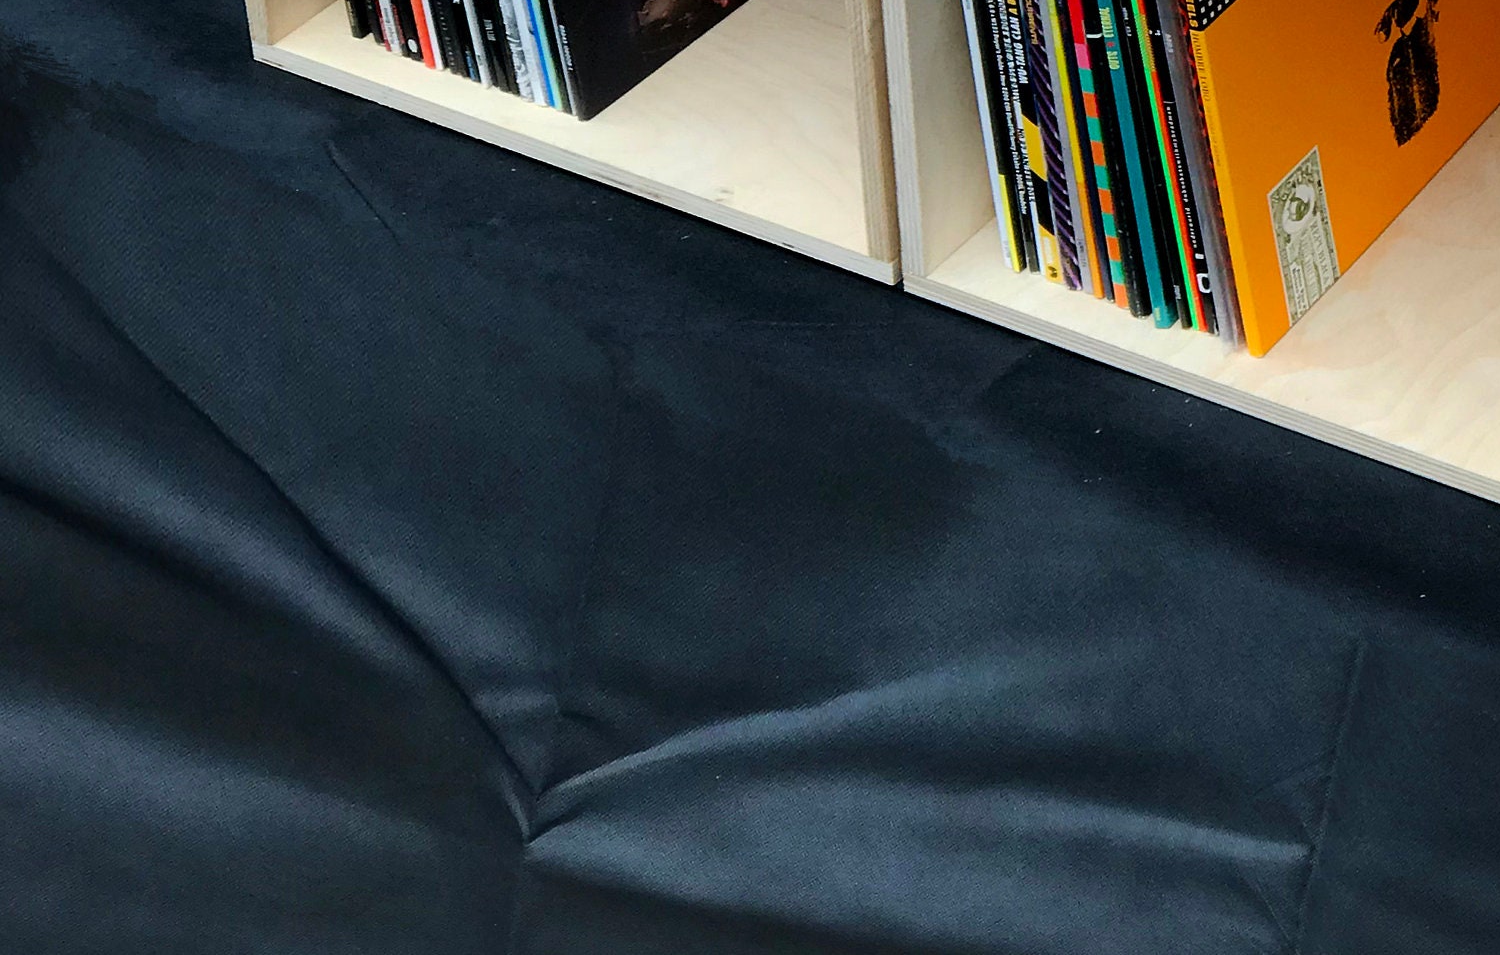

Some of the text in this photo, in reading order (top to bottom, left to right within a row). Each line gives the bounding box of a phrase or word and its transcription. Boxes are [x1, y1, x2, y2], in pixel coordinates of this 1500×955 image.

[1009, 16, 1023, 40] CLAN
[1192, 33, 1211, 102] HOMBRE LOBO
